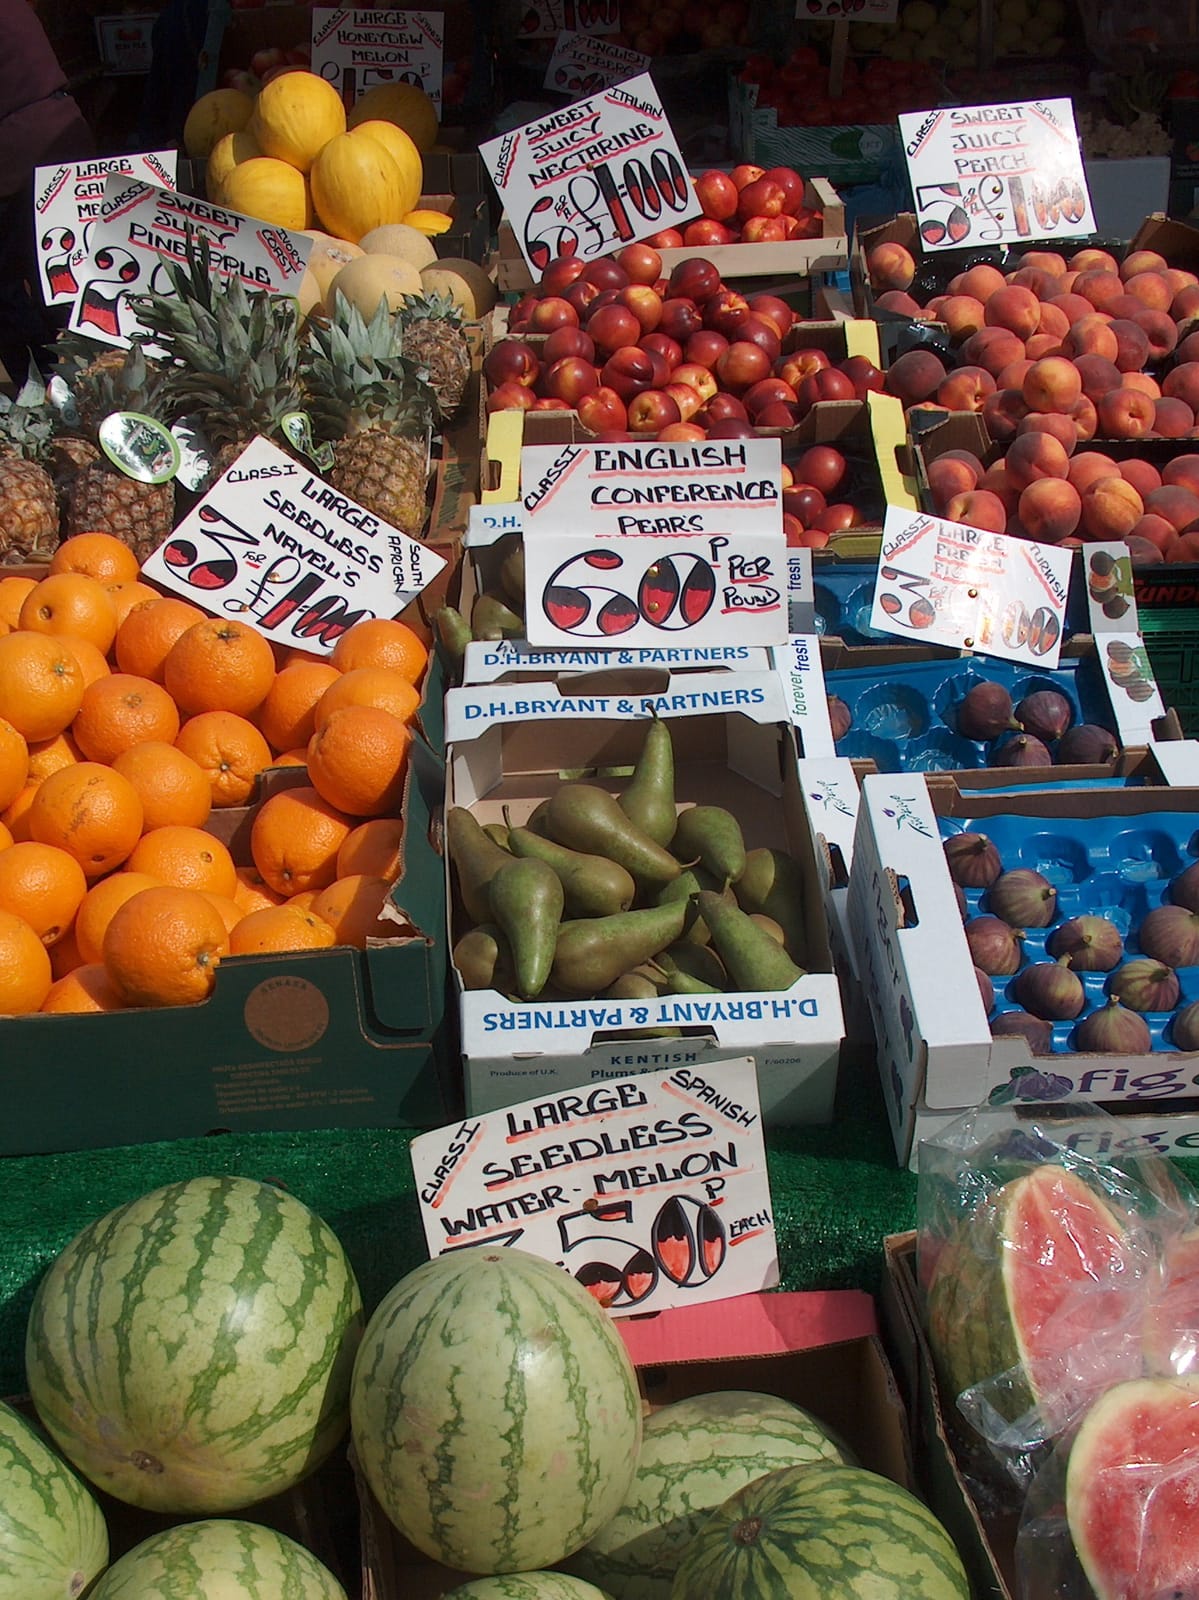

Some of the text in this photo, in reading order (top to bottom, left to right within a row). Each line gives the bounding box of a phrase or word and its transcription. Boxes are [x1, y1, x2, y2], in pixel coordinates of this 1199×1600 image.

[353, 11, 407, 25] LARGE
[337, 30, 424, 45] HONEYDEW
[352, 50, 409, 63] MELON
[587, 39, 647, 68] ENGLISH
[607, 88, 664, 118] ITALIAN
[950, 106, 1025, 126] SWEET
[525, 101, 595, 140] SWEET
[533, 116, 602, 160] JUICY
[951, 125, 1028, 151] JUICY
[76, 158, 132, 177] LARGE
[528, 123, 655, 187] NECTARINE
[954, 151, 1029, 175] PEACH
[146, 153, 176, 188] SPANISH
[159, 190, 247, 230] SWEET
[915, 182, 971, 247] 5
[154, 210, 236, 245] JUICY
[275, 228, 306, 267] IVORY
[595, 444, 747, 472] ENGLISH
[300, 477, 381, 539] LARGE
[590, 480, 779, 506] CONFERENCE
[262, 490, 385, 576] SEEDLESS
[409, 543, 425, 588] SOUTH
[727, 554, 775, 580] PER
[936, 542, 1003, 568] FREH
[787, 557, 801, 591] fresh
[1029, 542, 1067, 603] TURKISH
[618, 649, 634, 665] &
[640, 646, 749, 663] PARTNERS
[791, 639, 810, 672] fresh
[617, 699, 634, 713] &
[640, 688, 765, 713] PARTNERS
[790, 671, 808, 716] forever
[483, 1007, 622, 1032] PARTNERS
[630, 1006, 649, 1022] &
[490, 1069, 527, 1078] Produce
[528, 1069, 539, 1077] of
[591, 1068, 636, 1080] Plums
[610, 1053, 698, 1066] KENTISH
[669, 1069, 758, 1128] SPANISH
[1077, 1067, 1199, 1100] fig
[506, 1083, 648, 1137] LARGE
[482, 1112, 713, 1188] SEEDLESS
[729, 1208, 771, 1238] EACH
